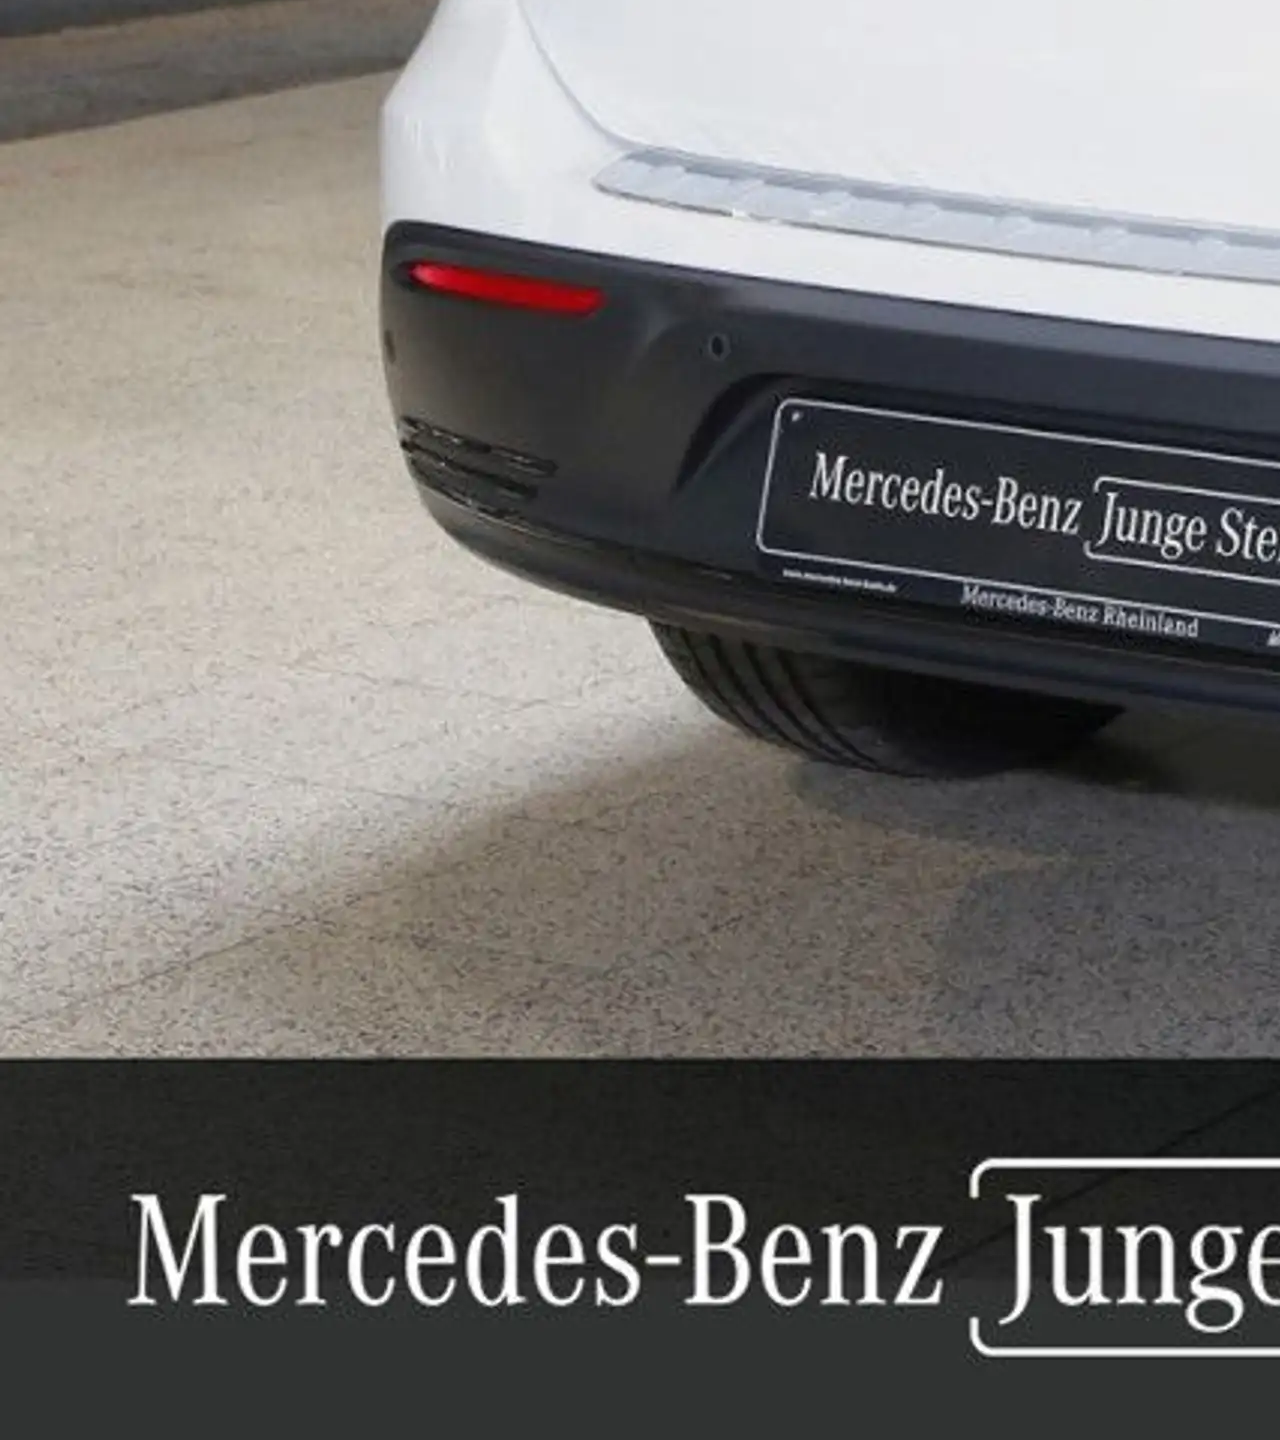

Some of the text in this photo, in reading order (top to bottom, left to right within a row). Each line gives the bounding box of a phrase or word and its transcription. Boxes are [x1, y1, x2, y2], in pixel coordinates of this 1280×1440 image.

[809, 451, 1083, 535] Mercedes-Benz
[1096, 491, 1207, 557] Junge
[960, 583, 1199, 638] Mercedes-Benz Rheinland
